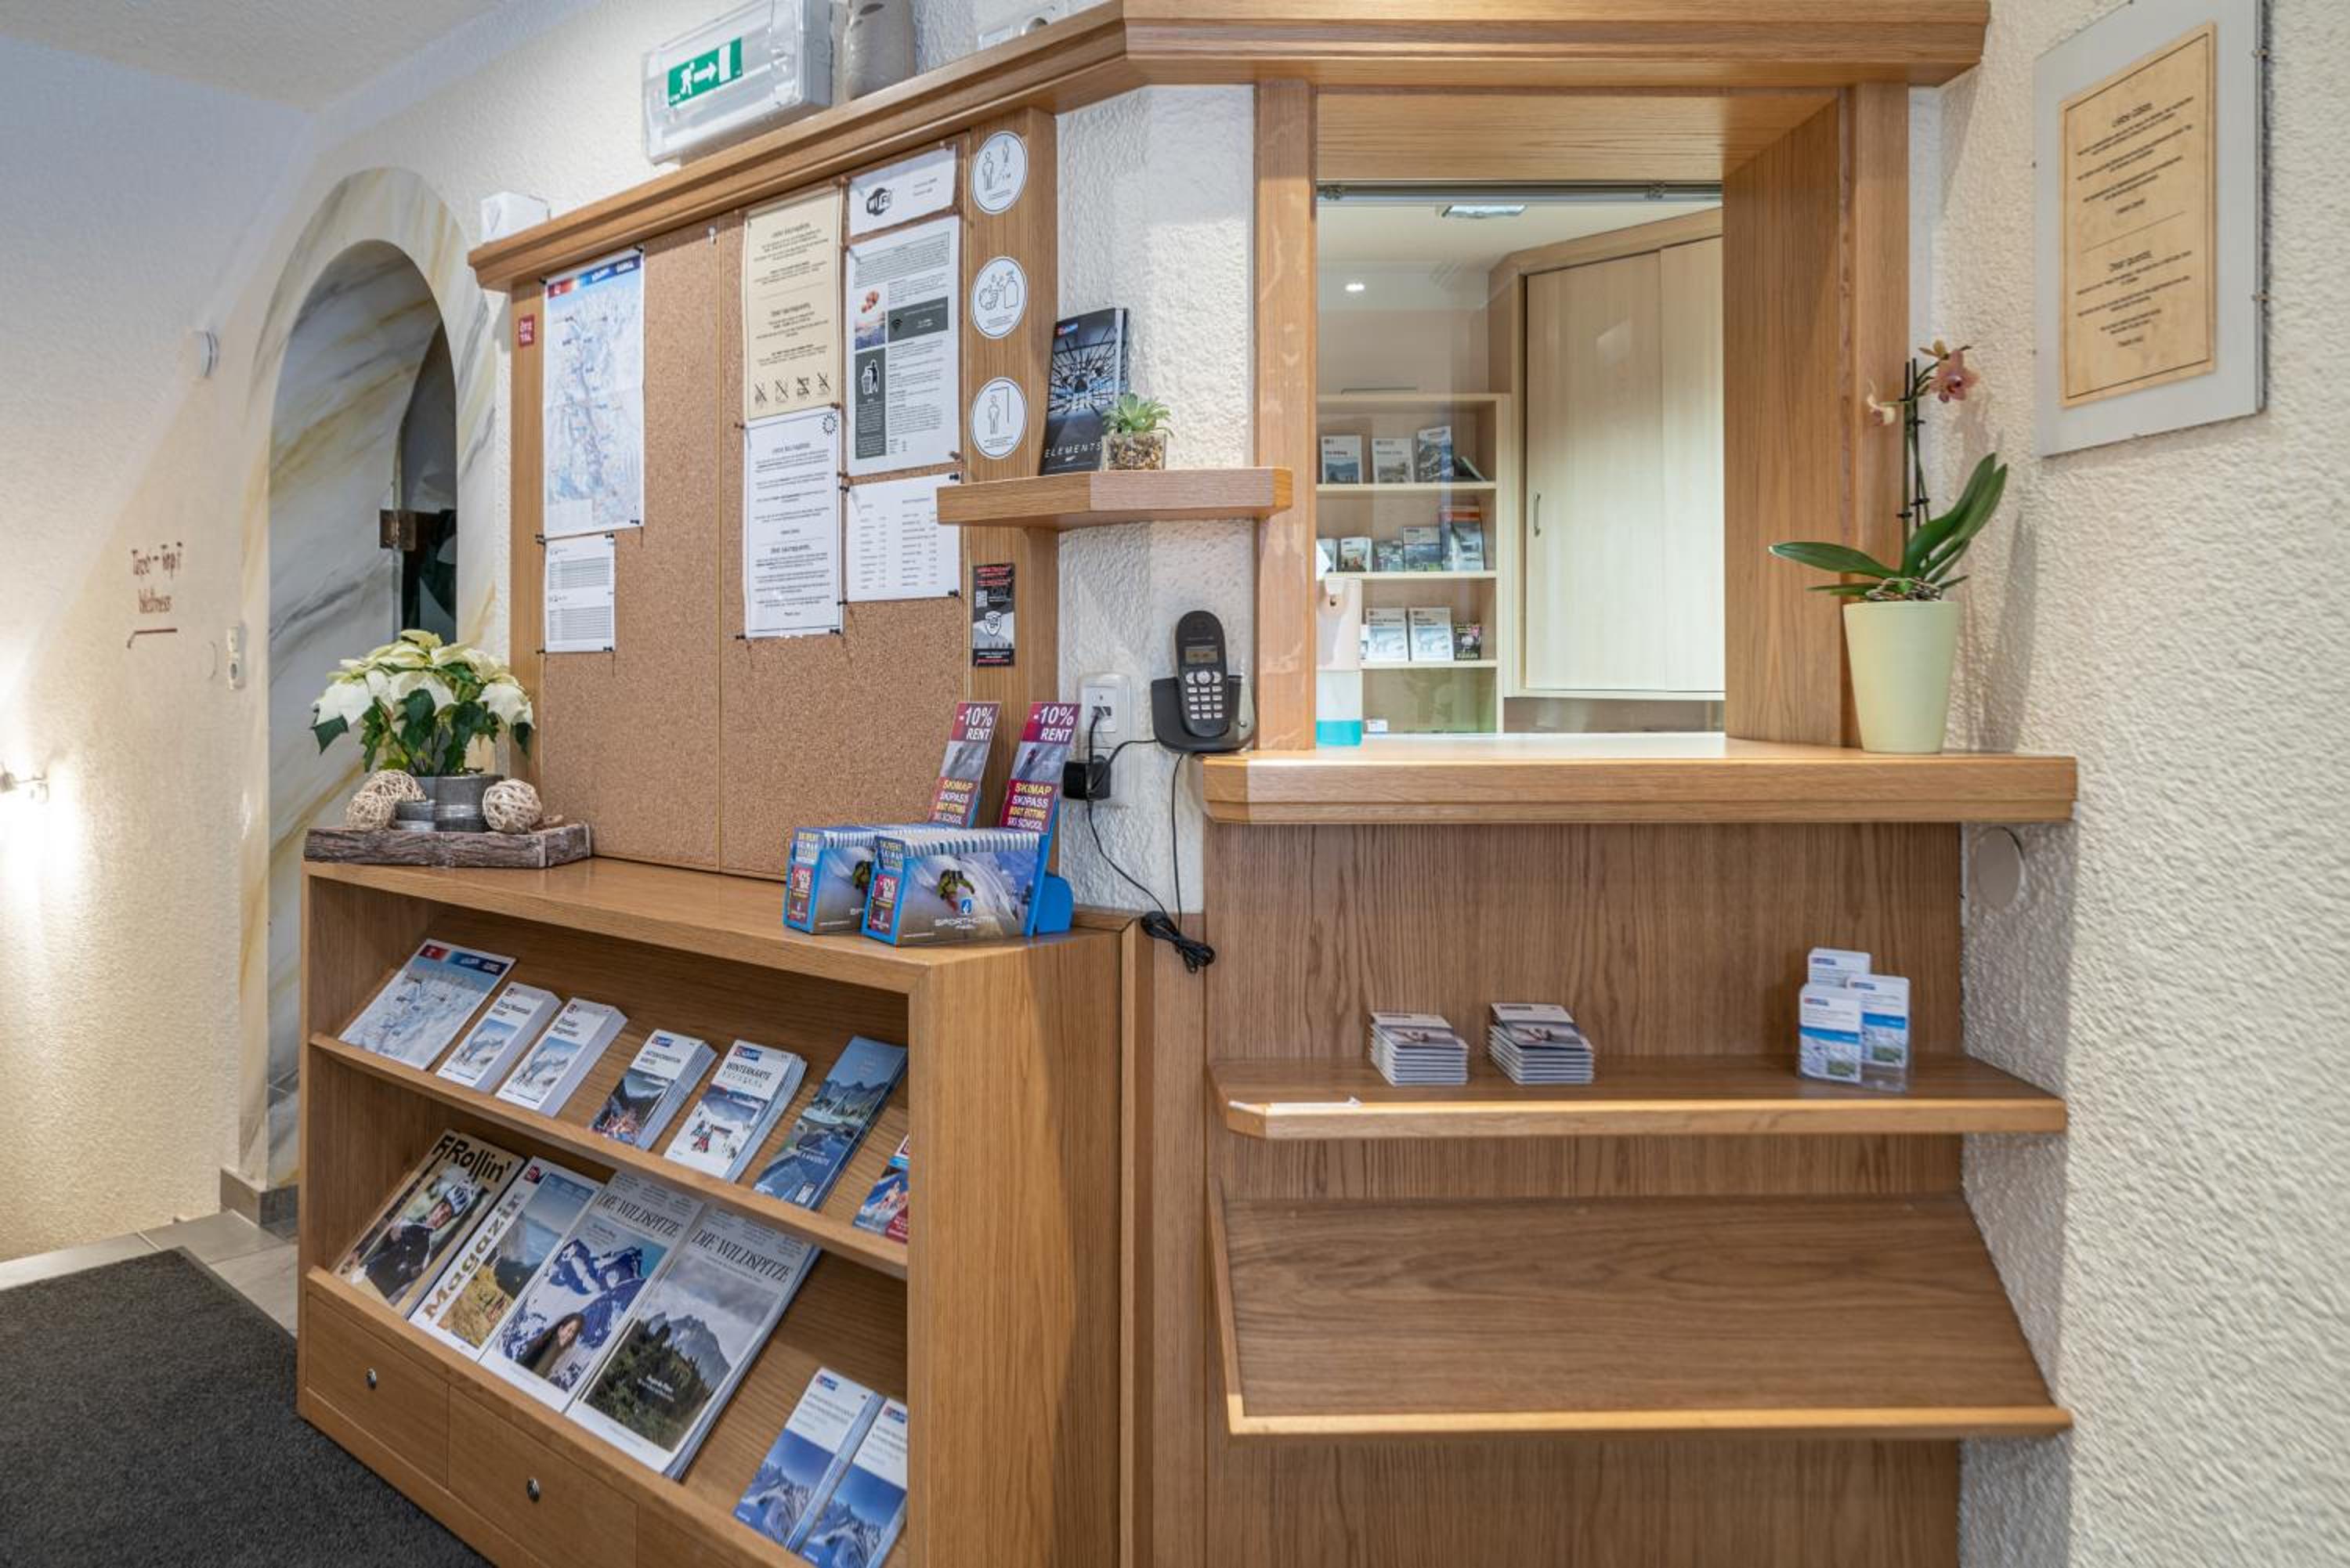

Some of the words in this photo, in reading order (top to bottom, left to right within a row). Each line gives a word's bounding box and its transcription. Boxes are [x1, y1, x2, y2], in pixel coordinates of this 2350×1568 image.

[1044, 441, 1102, 458] ELEMENTS
[959, 706, 992, 727] -10%
[1033, 706, 1075, 726] -10%
[966, 728, 990, 740] RENT
[1040, 728, 1072, 742] RENT
[596, 1193, 624, 1211] DIE
[617, 1200, 684, 1237] WILDSPITZE
[691, 1227, 718, 1251] DIE
[718, 1237, 793, 1281] WILDSPITZE
